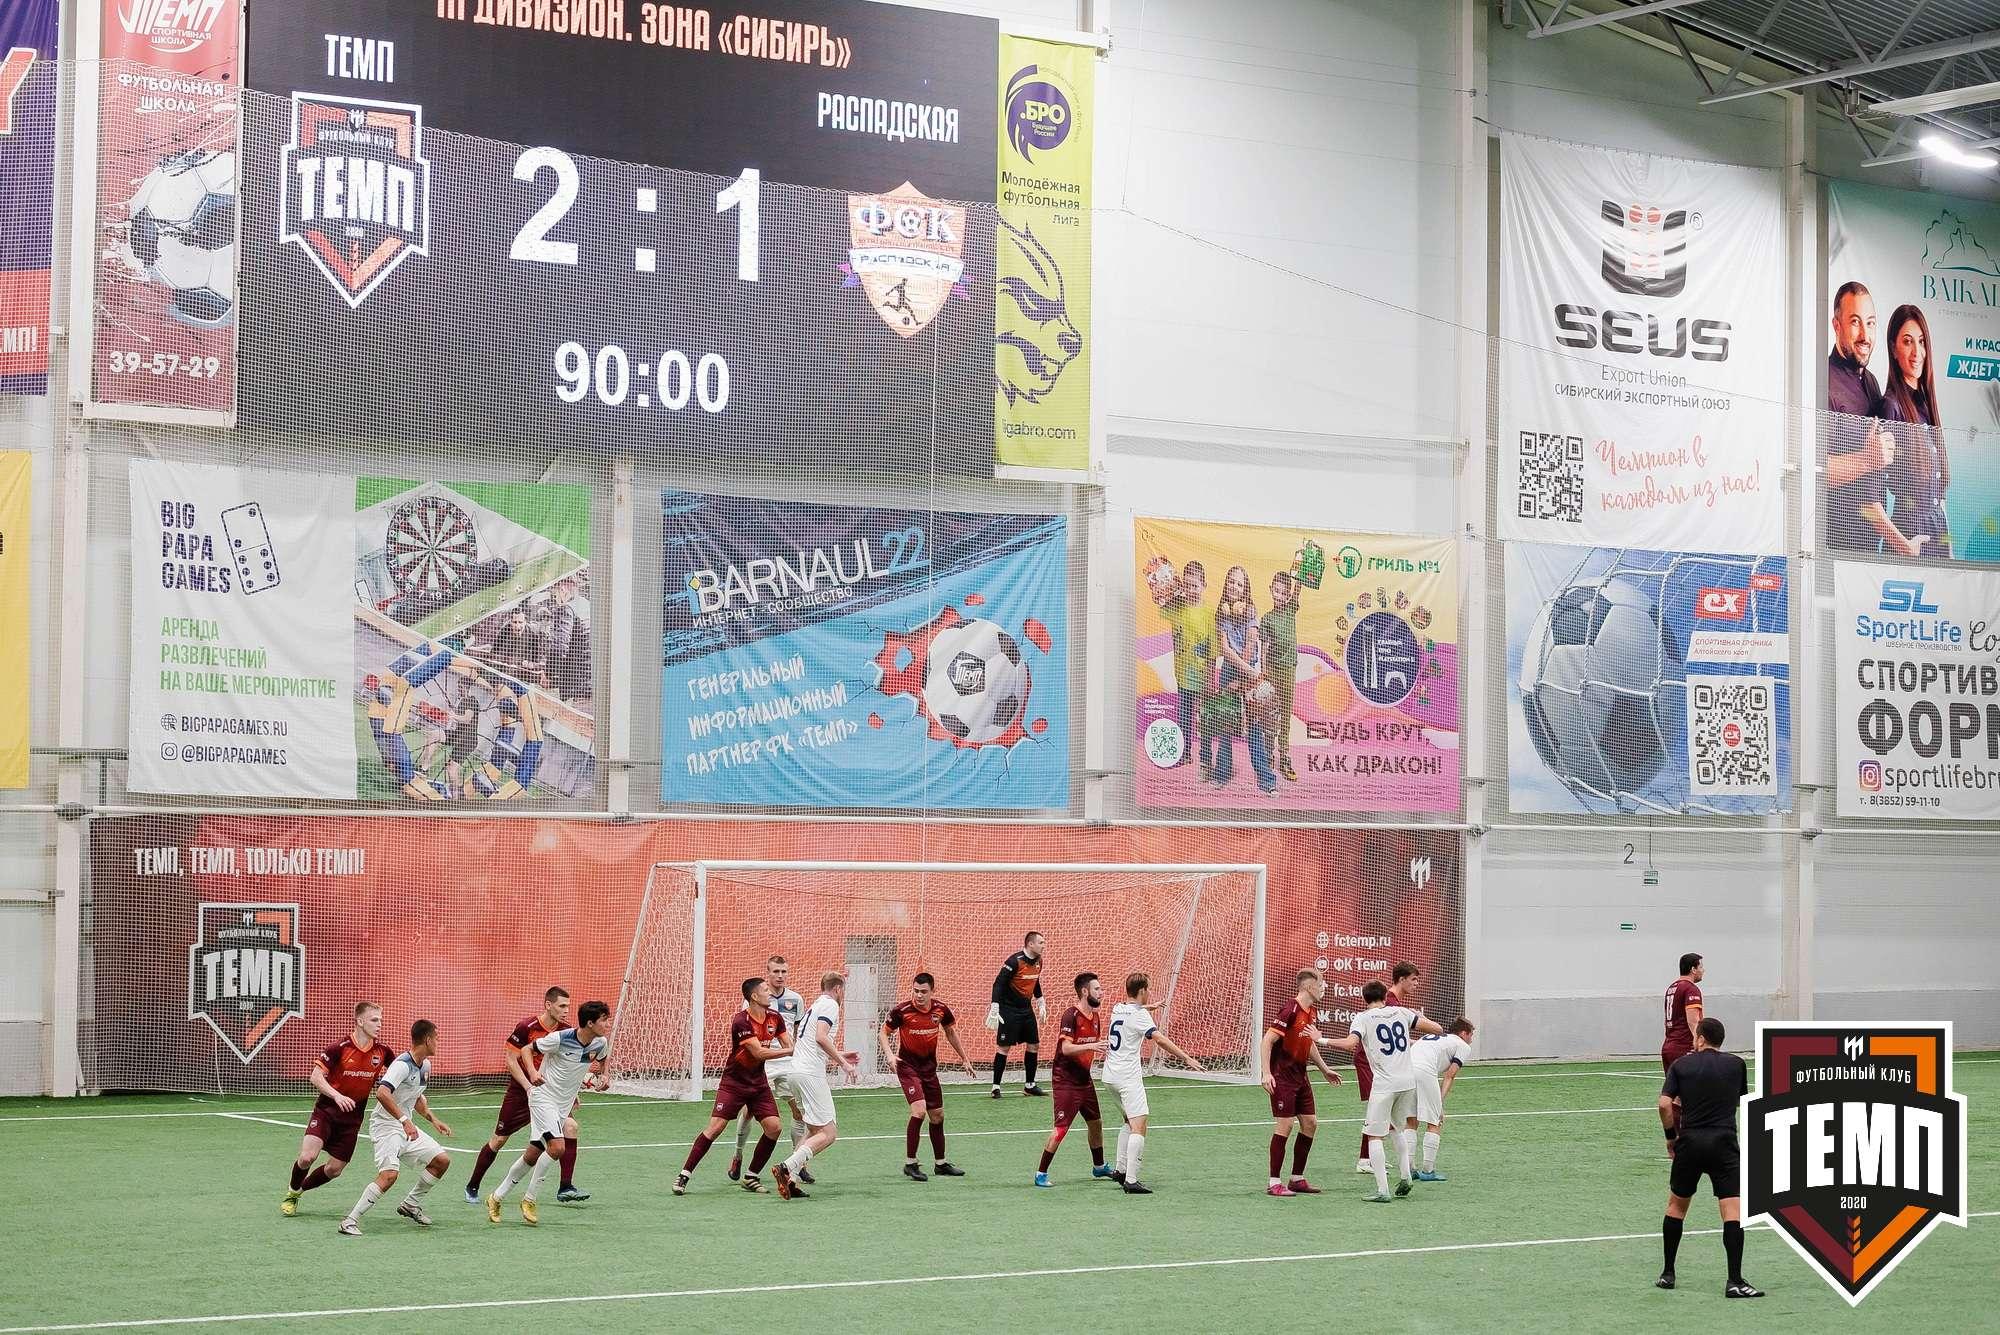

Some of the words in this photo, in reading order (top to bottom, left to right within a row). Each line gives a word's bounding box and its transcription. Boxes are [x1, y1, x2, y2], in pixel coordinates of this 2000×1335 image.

[151, 27, 212, 41] СПОРТИВНАЯ
[151, 36, 187, 46] ШКОЛА
[641, 2, 710, 51] ЗОНА
[717, 14, 851, 69] «СИБИРЬ»
[325, 33, 395, 83] ТЕМП
[118, 72, 224, 97] ФУТБОЛЬНАЯ
[141, 95, 197, 114] ШКОЛА
[817, 91, 959, 144] РАСПАДСКАЯ
[297, 156, 415, 233] ТЕМП
[1002, 170, 1081, 195] Молодёжная
[509, 146, 580, 266] 2
[716, 167, 760, 282] 1
[1003, 188, 1080, 211] футбольная
[1052, 213, 1080, 227] лига
[1555, 303, 1732, 362] SEUS
[1965, 337, 1973, 349] И
[109, 349, 220, 379] 39-57-29
[555, 341, 730, 413] 90:00
[1601, 364, 1646, 387] Export
[1649, 369, 1687, 388] Union
[1957, 359, 1995, 378] ЖДЕТ
[1554, 383, 1622, 402] СИБИРСКИЙ
[1624, 390, 1699, 409] ЭКСПОРТНЫЙ
[1701, 398, 1731, 411] СОЮЗ
[1595, 439, 1690, 476] Чемпион
[1601, 475, 1689, 512] каждом
[1694, 479, 1719, 508] из
[1721, 458, 1760, 496] нас!
[160, 499, 196, 530] BIG
[162, 531, 215, 562] PAPA
[161, 562, 231, 594] GAMES
[1368, 557, 1414, 573] ГРИЛЬ
[1418, 560, 1441, 574] №1
[692, 606, 757, 629] ИНТЕРНЕТ
[768, 586, 853, 614] СООБЩЕСТВО
[161, 615, 220, 642] АРЕНДА
[1856, 614, 1962, 643] SportLife
[161, 643, 268, 670] РАЗВЛЕЧЕНИЙ
[160, 670, 182, 691] НА
[186, 671, 229, 694] ВАШЕ
[232, 674, 337, 699] МЕРОПРИЯТИЕ
[687, 652, 806, 702] ГЕНЕРАЛЬНЫЙ
[1857, 658, 1998, 696] СПОРТИВ
[687, 679, 848, 741] ИНФОРМАЦИОННЫЙ
[181, 714, 288, 737] BIGPAPAGAMES.RU
[1306, 720, 1370, 745] БУДЬ
[1376, 722, 1431, 746] КРУТ,
[181, 744, 288, 767] @BIGPAPAGAMES
[686, 739, 762, 777] ПАРТНЕР
[766, 731, 795, 758] ФК
[799, 718, 859, 749] «ТЕМП»
[1307, 753, 1349, 773] КАК
[1353, 754, 1443, 778] ДРАКОН!
[1869, 795, 1904, 807] 8(3852)
[1905, 796, 1941, 808] 59-11-10
[134, 847, 184, 877] ТЕМП,
[189, 847, 241, 878] ТЕМП,
[245, 848, 312, 876] ТОЛЬКО
[316, 848, 365, 876] ТЕМП!
[1623, 843, 1635, 865] 2
[1334, 933, 1392, 950] fctemp.ru
[203, 948, 293, 1002] ТЕМП
[1333, 958, 1353, 972] ФК
[1355, 958, 1387, 971] Темп
[1110, 1020, 1124, 1052] 5
[1375, 1021, 1407, 1056] 98
